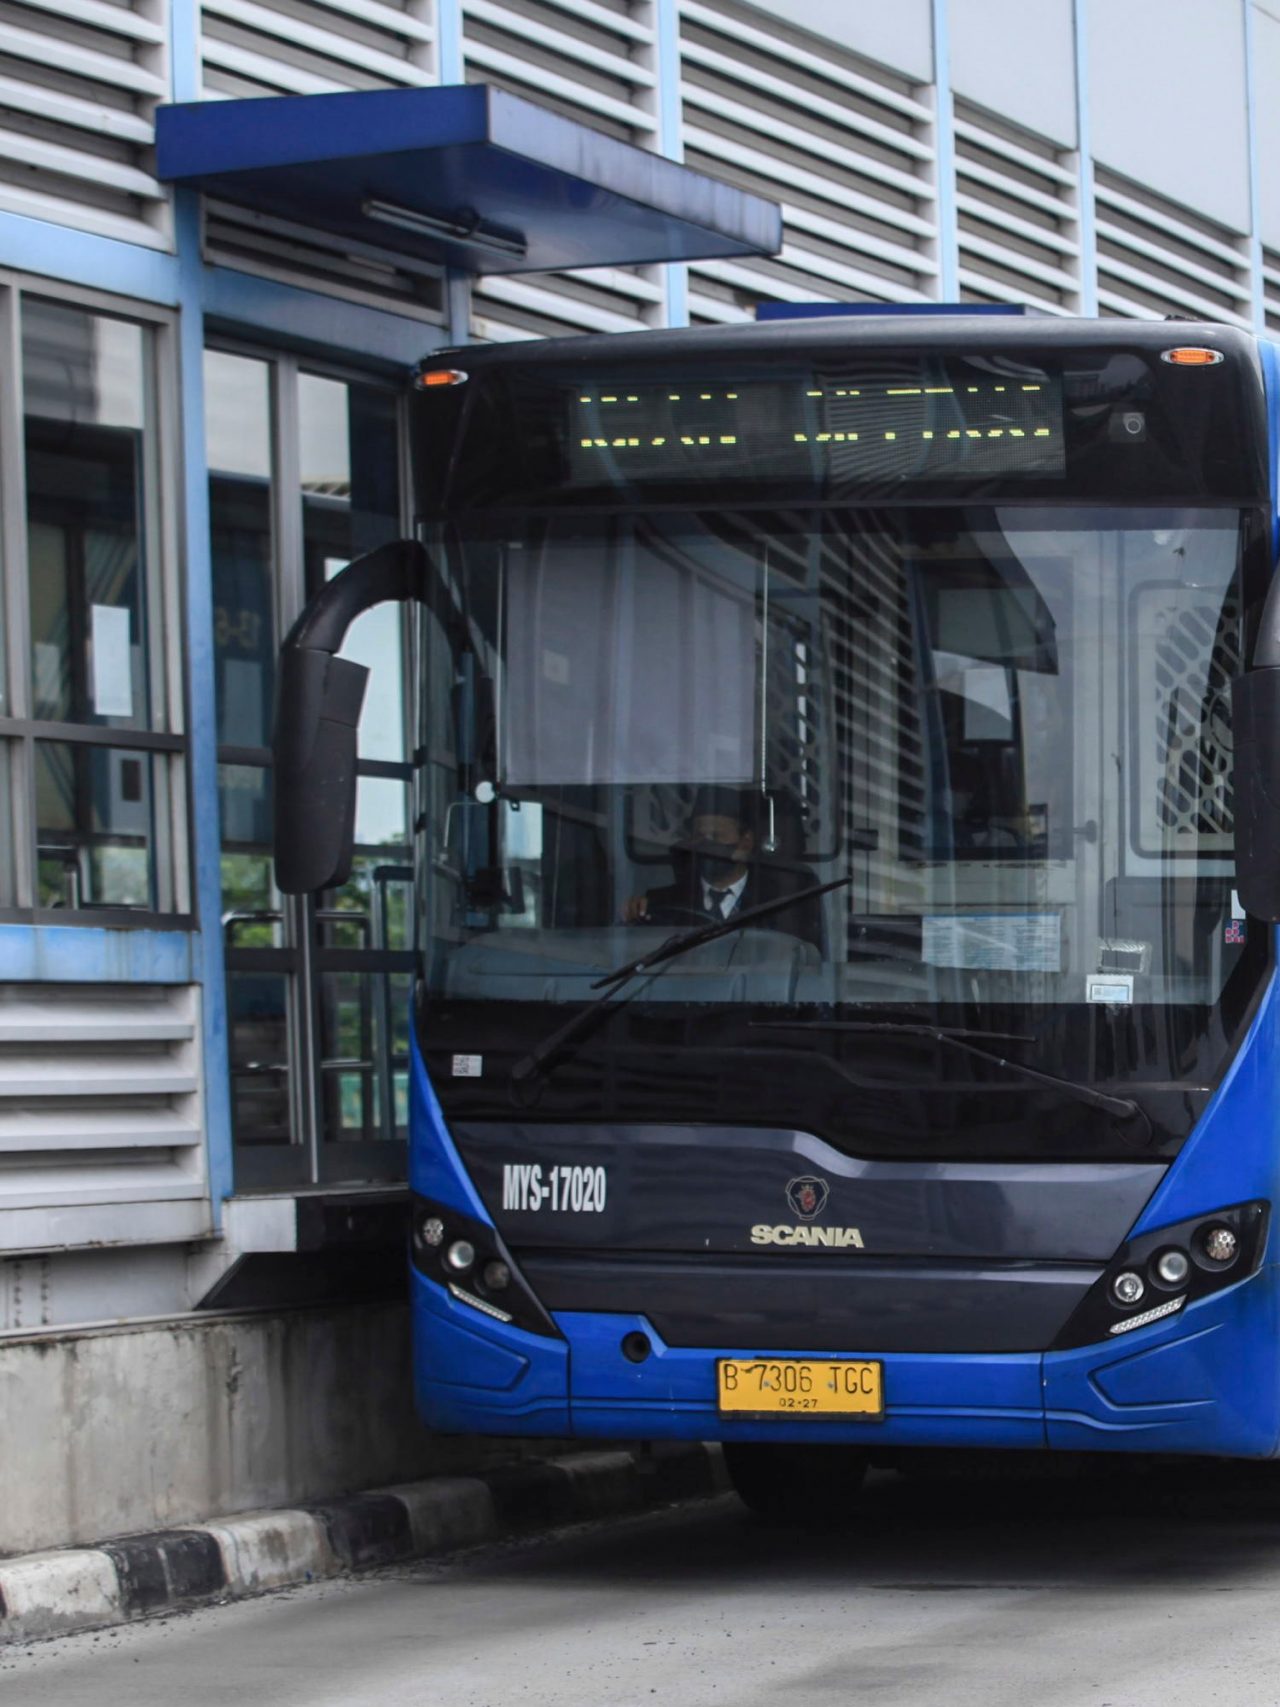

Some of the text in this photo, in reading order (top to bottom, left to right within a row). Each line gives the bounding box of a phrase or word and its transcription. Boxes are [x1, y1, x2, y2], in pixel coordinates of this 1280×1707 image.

[503, 1163, 606, 1213] MYS-17020
[751, 1224, 865, 1248] SCANIA
[724, 1364, 873, 1394] B 7306 TGC
